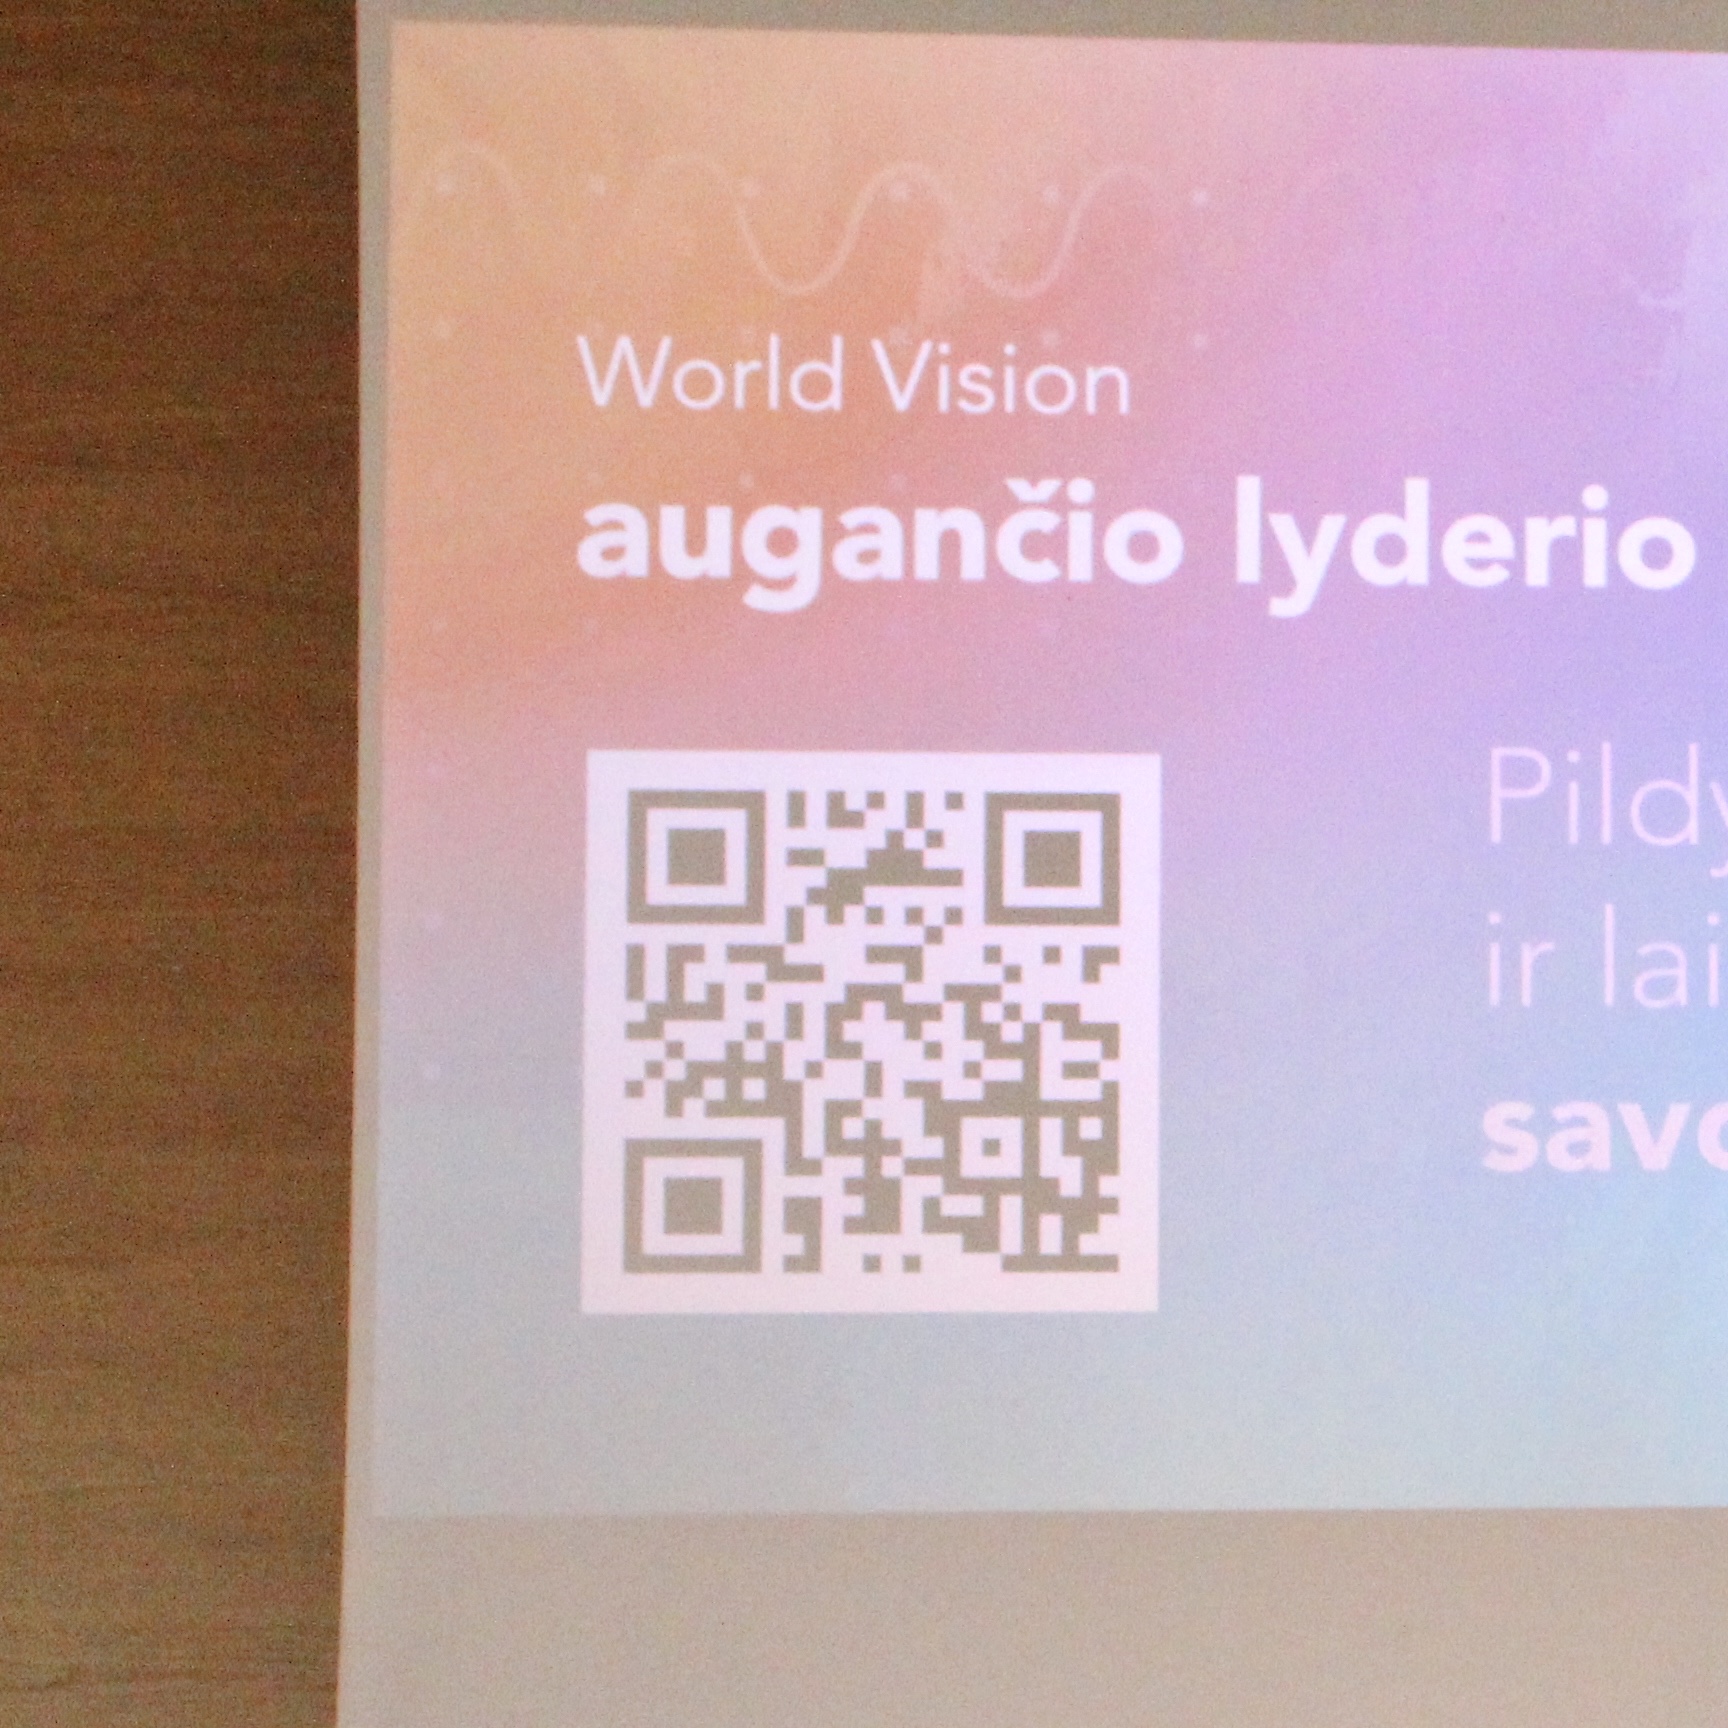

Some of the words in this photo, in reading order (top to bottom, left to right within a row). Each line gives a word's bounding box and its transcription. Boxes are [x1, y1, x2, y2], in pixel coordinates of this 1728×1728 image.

[576, 333, 845, 414] World
[870, 338, 1132, 416] Vision
[576, 477, 1186, 613] augančio
[1235, 474, 1699, 619] lyderio
[1486, 908, 1555, 1009] ir
